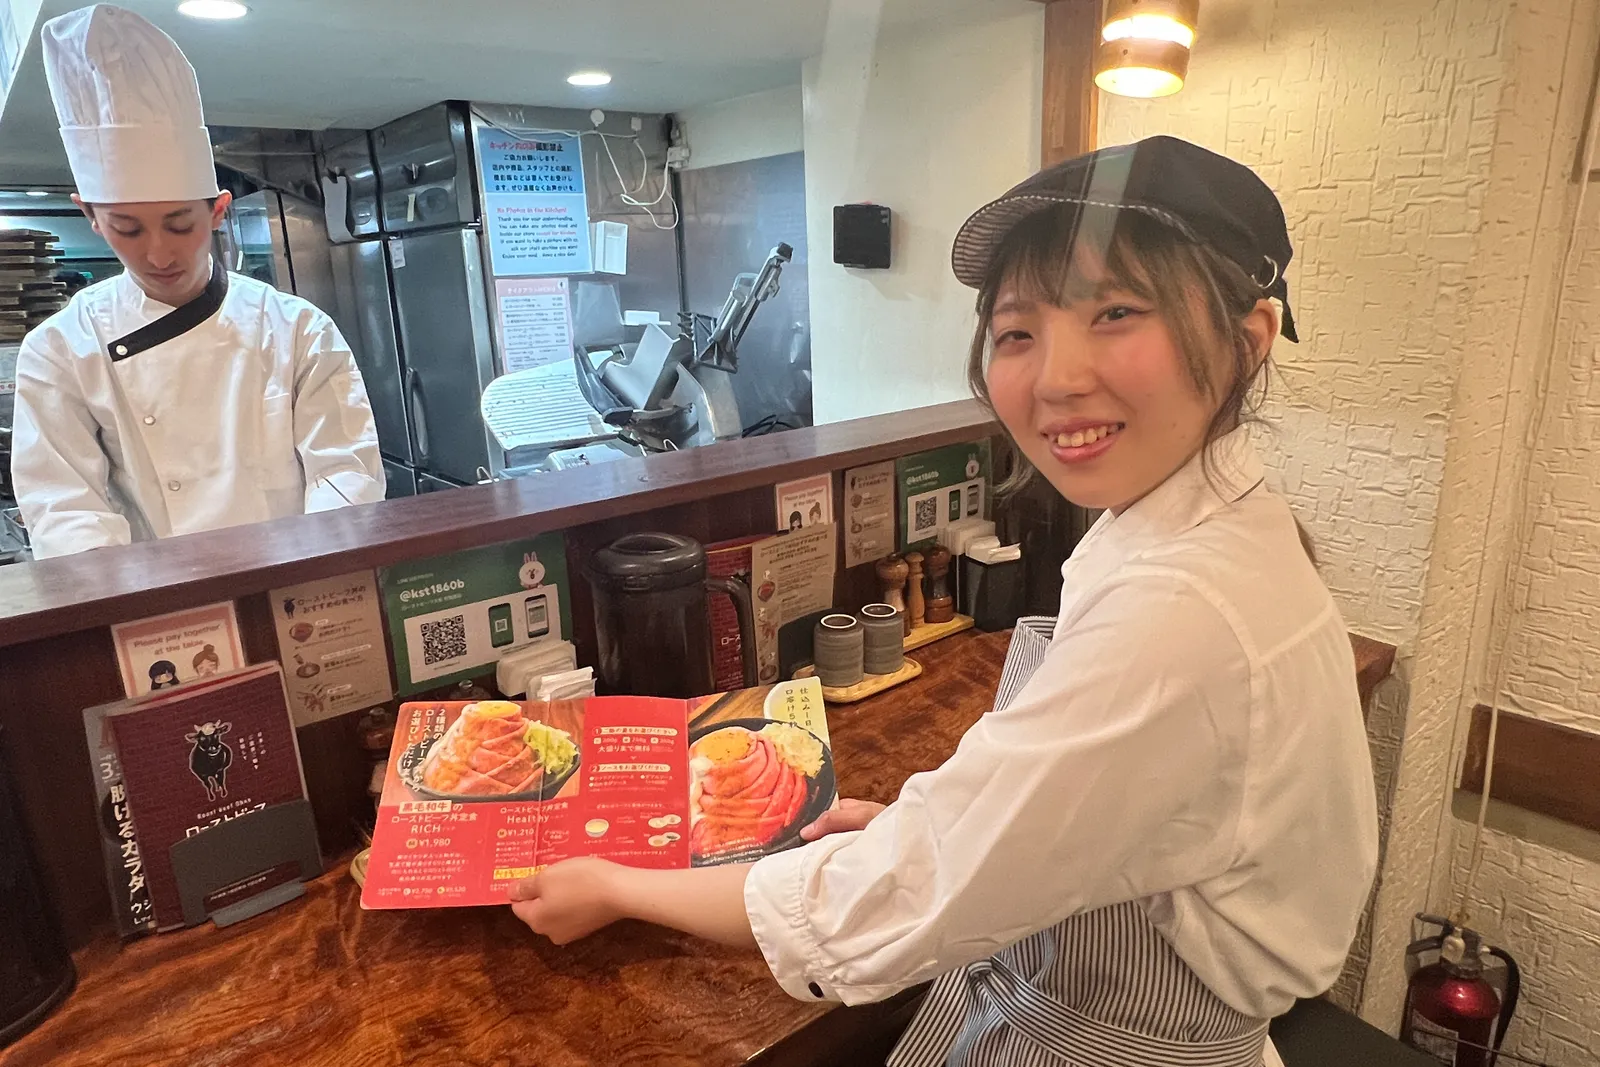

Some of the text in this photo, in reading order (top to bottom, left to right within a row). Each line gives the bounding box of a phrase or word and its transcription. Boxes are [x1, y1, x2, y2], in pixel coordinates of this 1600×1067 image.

[297, 585, 367, 605] ローストビーフ丼の
[400, 579, 465, 602] @kst1860b
[134, 623, 222, 648] Please pay together
[166, 645, 181, 653] the
[391, 812, 478, 824] ローストビーフ丼定食
[506, 814, 550, 824] Healthy
[411, 823, 442, 834] RICH
[419, 837, 451, 848] ¥1,980
